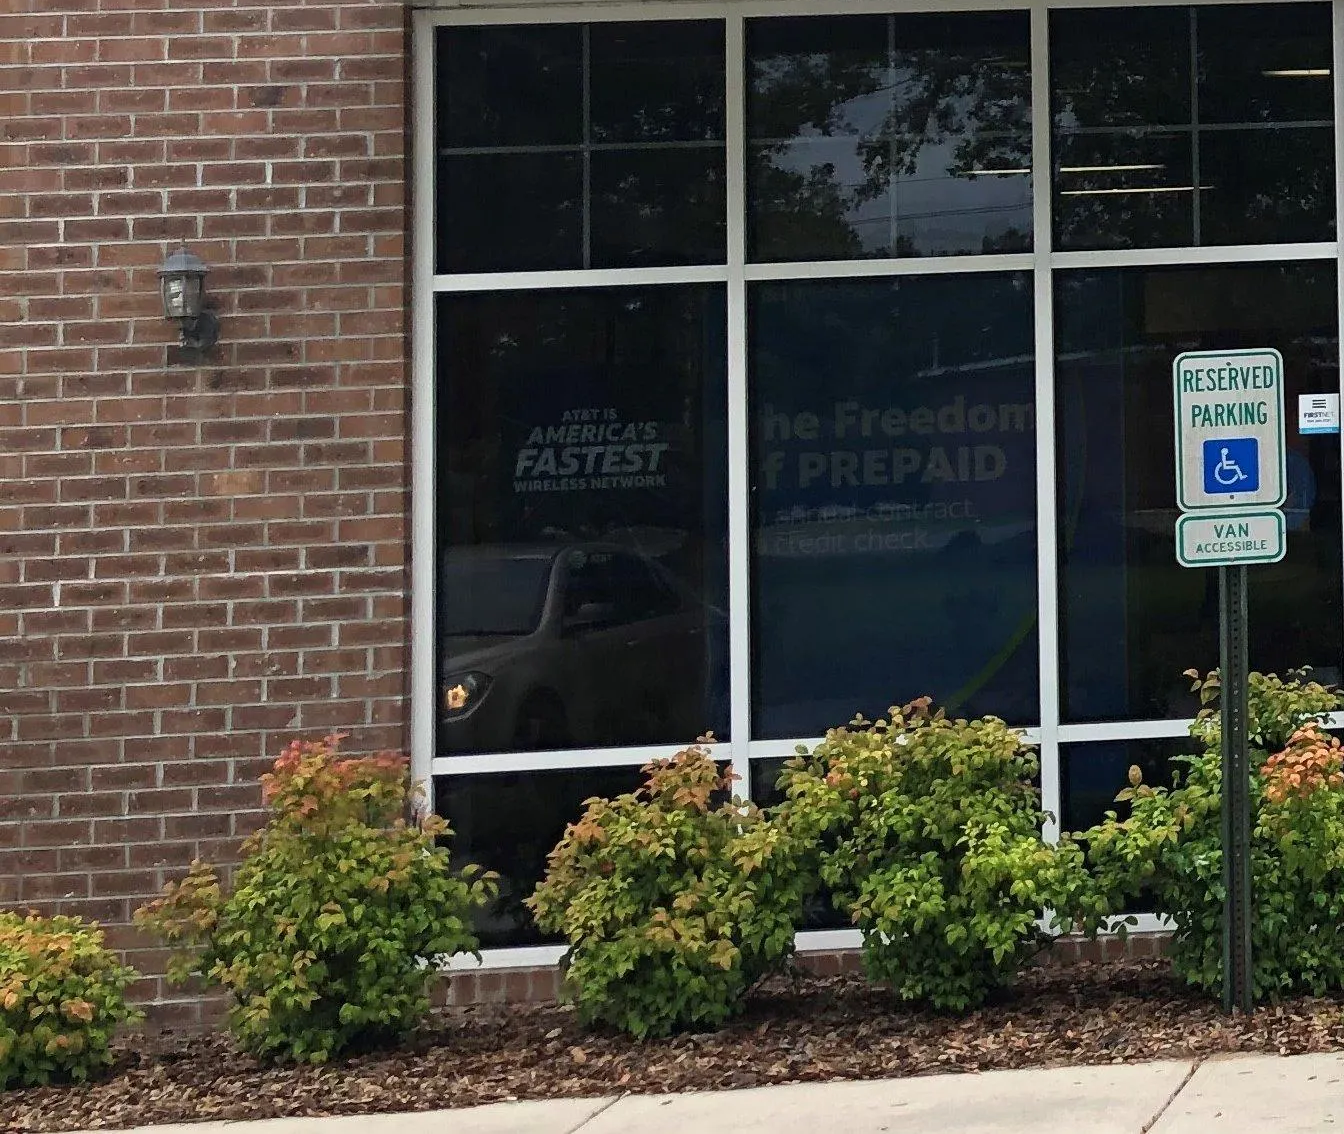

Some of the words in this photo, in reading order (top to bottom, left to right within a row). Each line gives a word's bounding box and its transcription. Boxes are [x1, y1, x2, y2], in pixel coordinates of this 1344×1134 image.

[1183, 365, 1274, 393] RESERVED
[761, 402, 820, 441] he
[834, 394, 1034, 437] Freedom
[1192, 400, 1268, 428] PARKING
[527, 421, 659, 446] AMERICA'S
[514, 442, 671, 478] FASTEST
[799, 444, 1008, 487] PREPAID
[513, 478, 588, 494] WIRELESS
[590, 474, 667, 491] NETWORK
[1213, 522, 1250, 539] VAN
[1196, 539, 1268, 554] ACCESSIBLE
